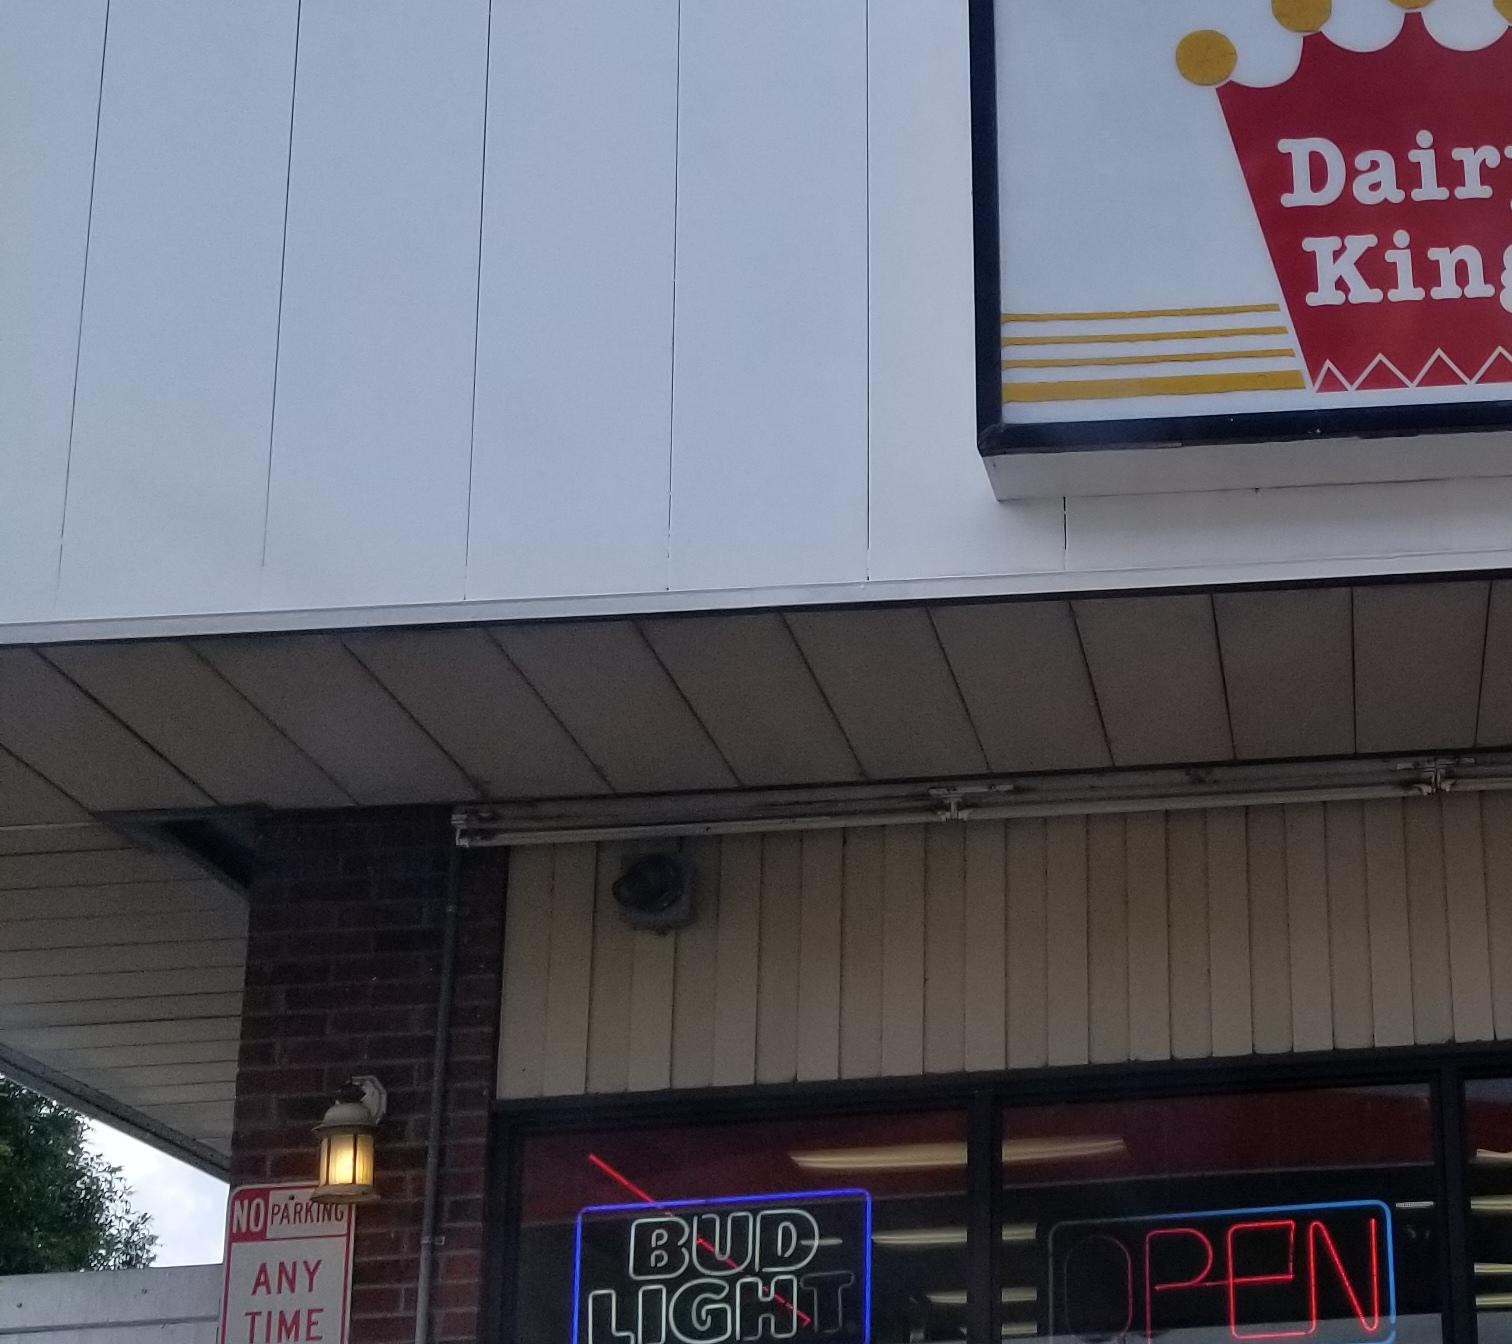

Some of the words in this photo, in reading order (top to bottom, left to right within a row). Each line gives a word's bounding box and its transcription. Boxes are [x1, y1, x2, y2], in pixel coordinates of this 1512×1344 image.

[232, 1198, 265, 1234] NO
[270, 1202, 344, 1226] PARKING
[628, 1209, 819, 1281] BUD
[251, 1259, 322, 1296] ANY
[244, 1308, 324, 1344] TIME
